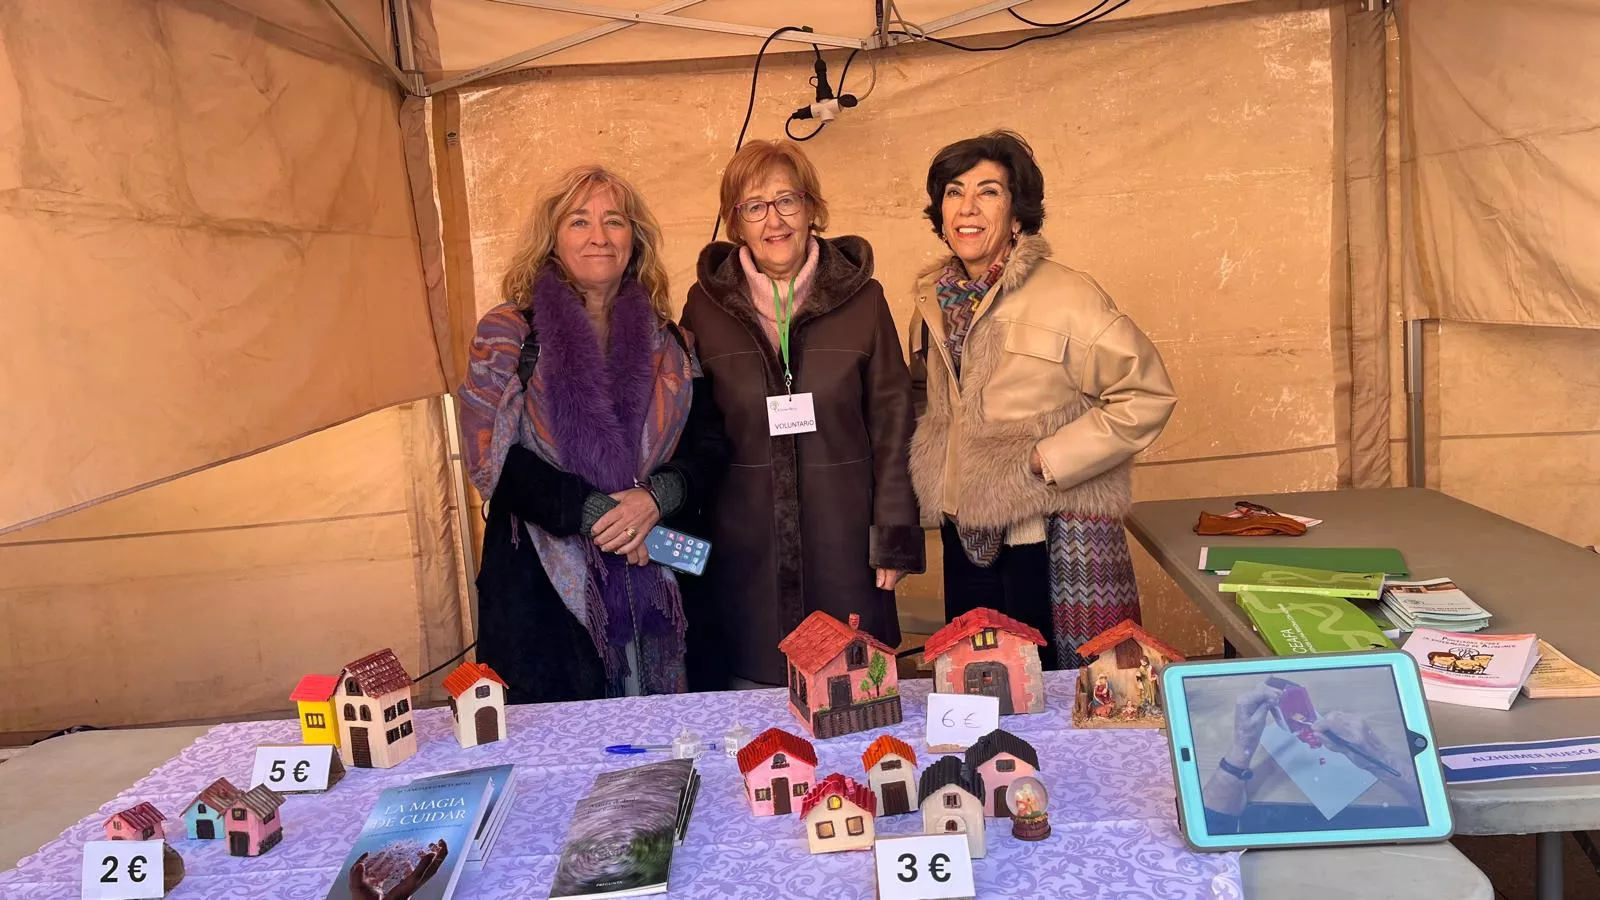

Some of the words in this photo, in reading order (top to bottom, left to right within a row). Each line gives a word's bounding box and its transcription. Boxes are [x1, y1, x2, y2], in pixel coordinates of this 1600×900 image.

[775, 420, 815, 430] VOLUNTARIO
[1280, 628, 1307, 654] CEAFA
[942, 708, 955, 727] 6
[964, 712, 981, 728] €
[1472, 752, 1544, 763] ALZHEIMER
[1545, 747, 1597, 759] HUESCA
[269, 759, 286, 783] 5
[292, 759, 311, 783] €
[384, 805, 404, 816] LA
[409, 796, 466, 811] MAGIA
[373, 817, 396, 829] DE
[400, 809, 467, 826] CUIDAR
[99, 855, 119, 883] 2
[127, 855, 148, 883] €
[897, 852, 919, 883] 3
[927, 852, 952, 883] €
